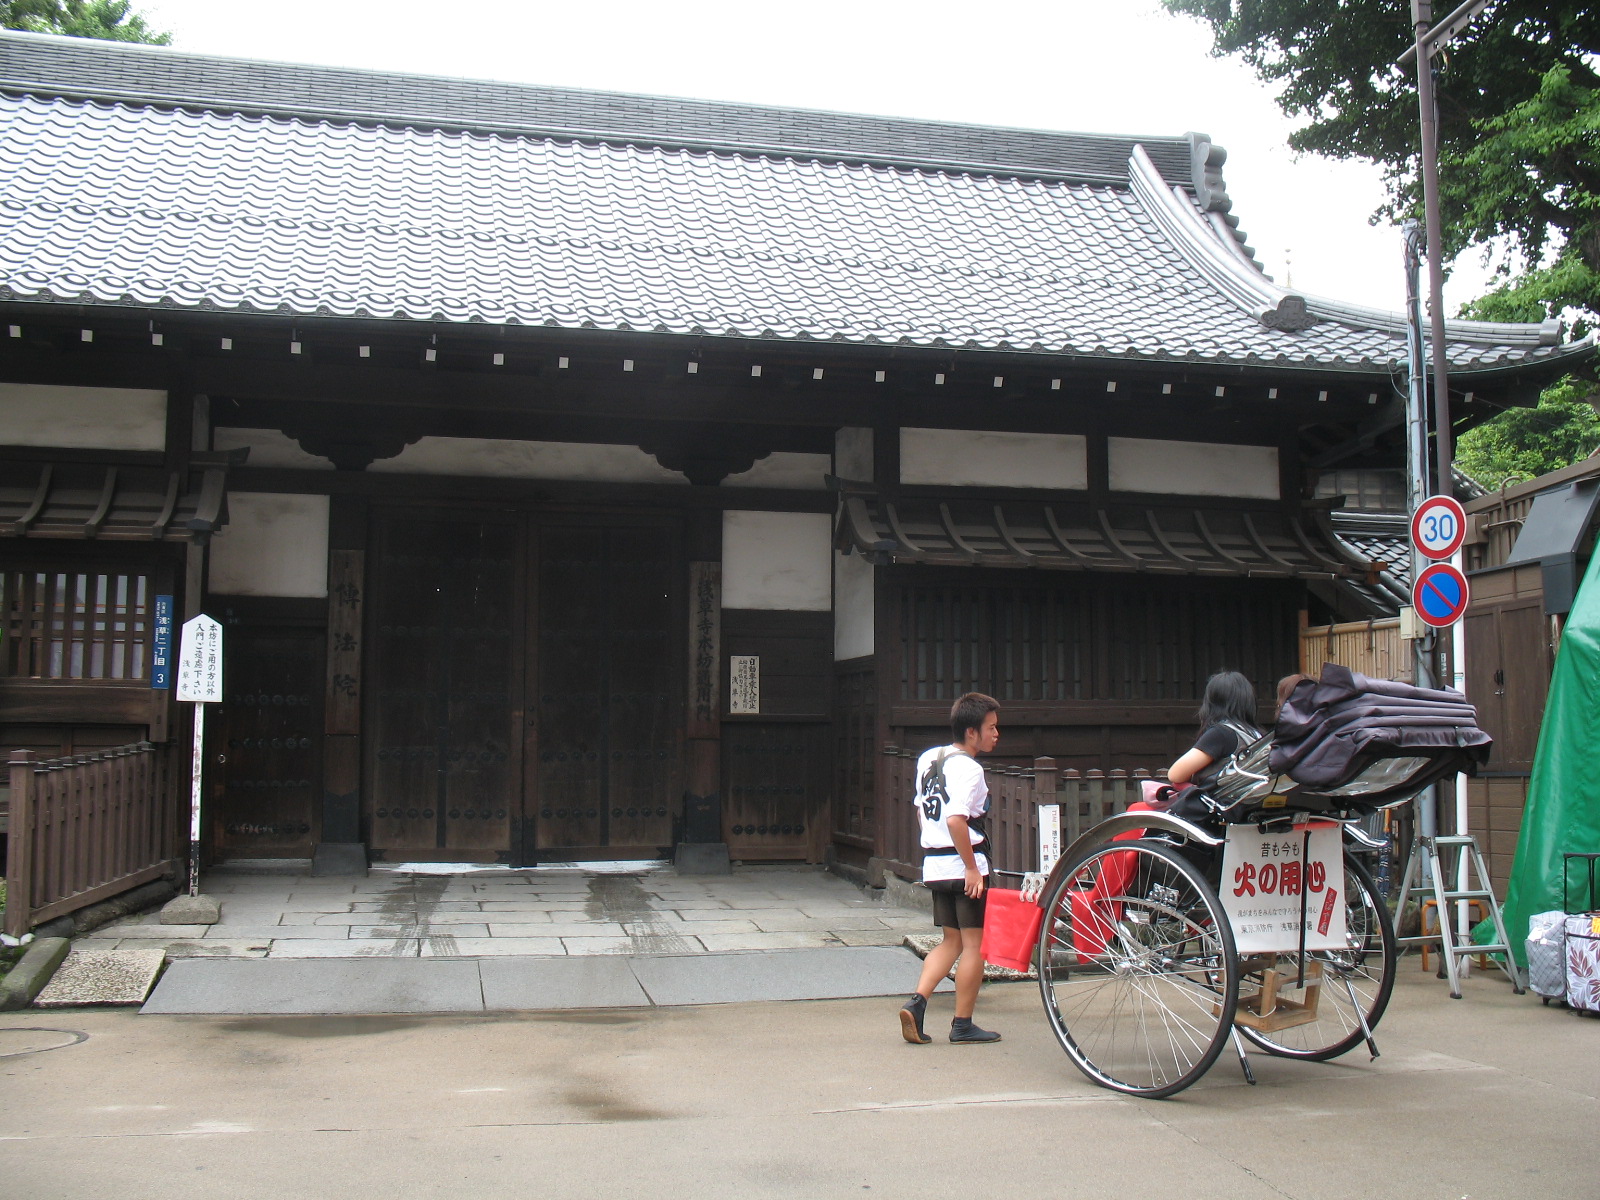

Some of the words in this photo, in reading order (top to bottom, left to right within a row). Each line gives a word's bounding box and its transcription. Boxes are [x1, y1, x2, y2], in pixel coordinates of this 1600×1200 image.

[1424, 514, 1453, 542] 30
[157, 616, 168, 666] 浅草二丁目
[193, 623, 205, 695] 入門ご遠慮下さい
[206, 623, 218, 696] 本坊にご用の方以外
[157, 673, 164, 683] 3
[181, 660, 190, 692] 浅草寺
[1261, 842, 1300, 858] 昔も今も
[1233, 861, 1326, 897] 火の用心
[1280, 921, 1313, 932] 浅草消署
